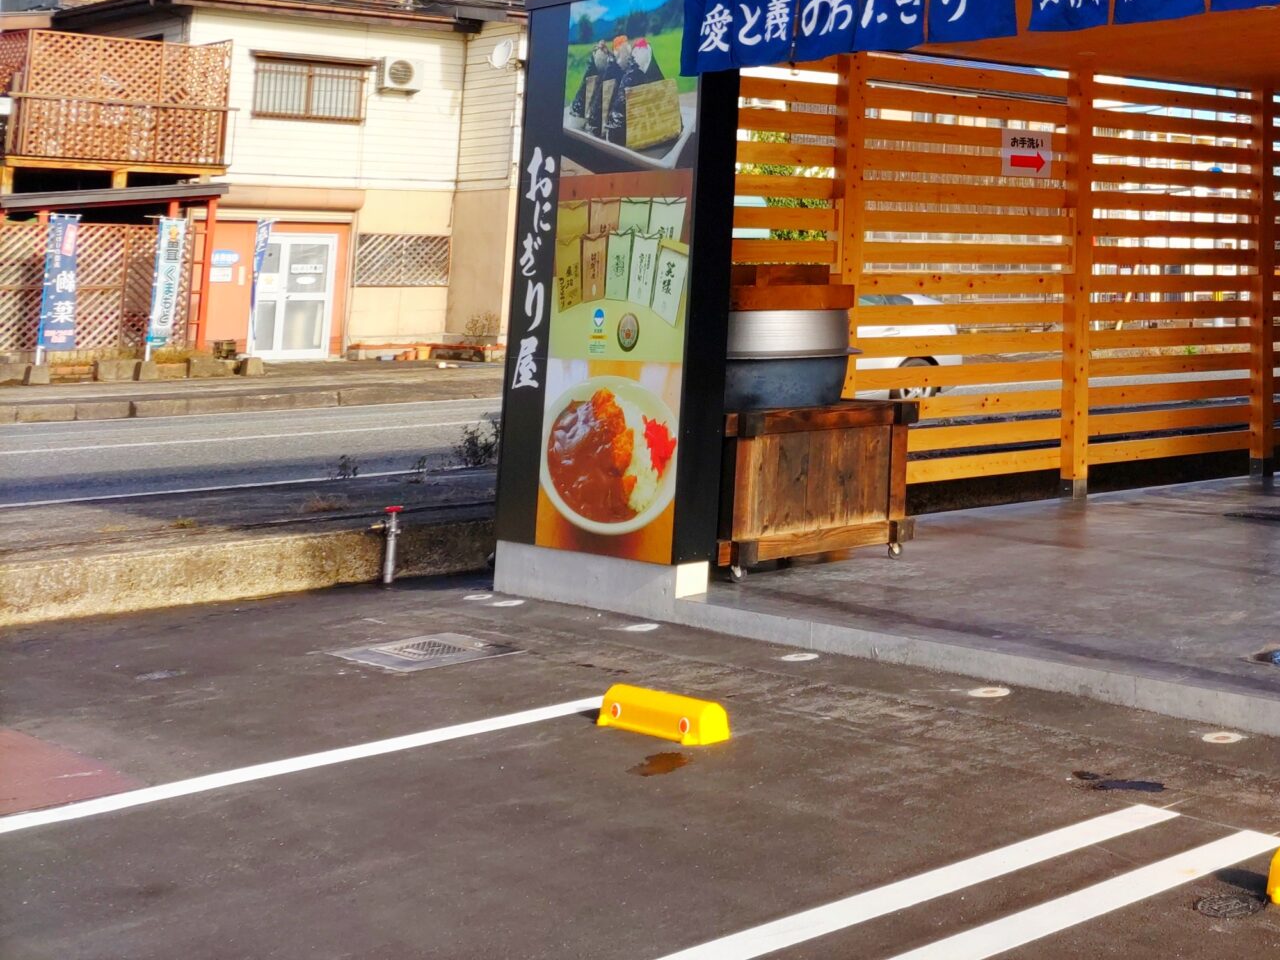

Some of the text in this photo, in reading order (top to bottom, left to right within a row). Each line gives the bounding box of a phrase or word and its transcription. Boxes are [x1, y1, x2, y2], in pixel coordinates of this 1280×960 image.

[1010, 137, 1044, 149] お手洗い
[512, 146, 555, 390] おにぎり屋
